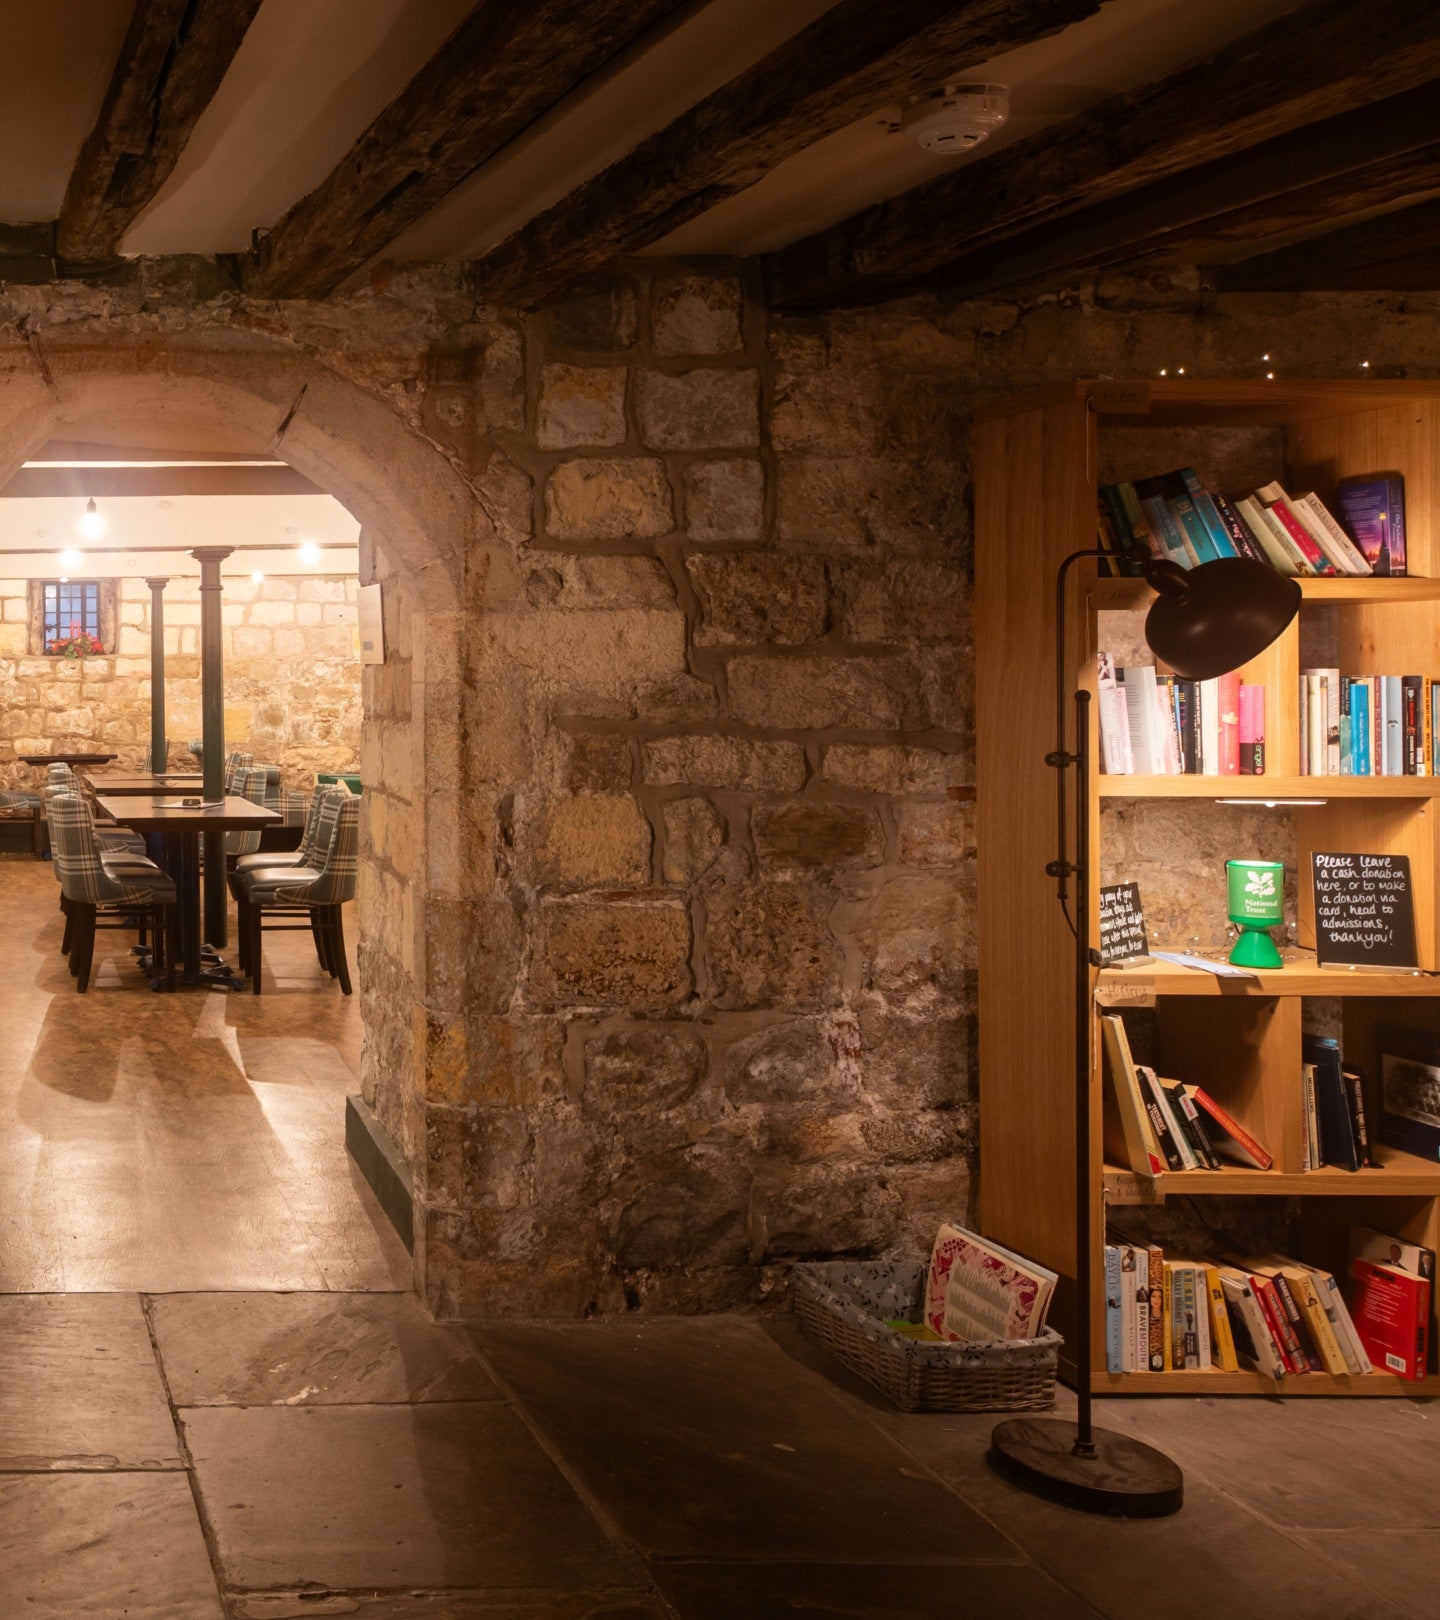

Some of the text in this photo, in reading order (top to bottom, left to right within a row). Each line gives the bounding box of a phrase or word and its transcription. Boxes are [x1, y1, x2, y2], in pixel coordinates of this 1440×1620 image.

[1316, 855, 1354, 868] Please
[1321, 867, 1405, 879] a cash donation
[1316, 880, 1406, 892] here, or to make
[1244, 899, 1278, 908] National
[1322, 892, 1399, 904] a donation via
[1245, 906, 1267, 914] Trust
[1318, 904, 1393, 917] card, head to
[1322, 916, 1389, 930] admissions,
[1151, 1103, 1167, 1132] TESTAMENT
[1107, 1254, 1117, 1292] BAYLIS
[1277, 1278, 1300, 1321] FRANK SKINNER
[1139, 1305, 1148, 1363] BRAVEMOUTH
